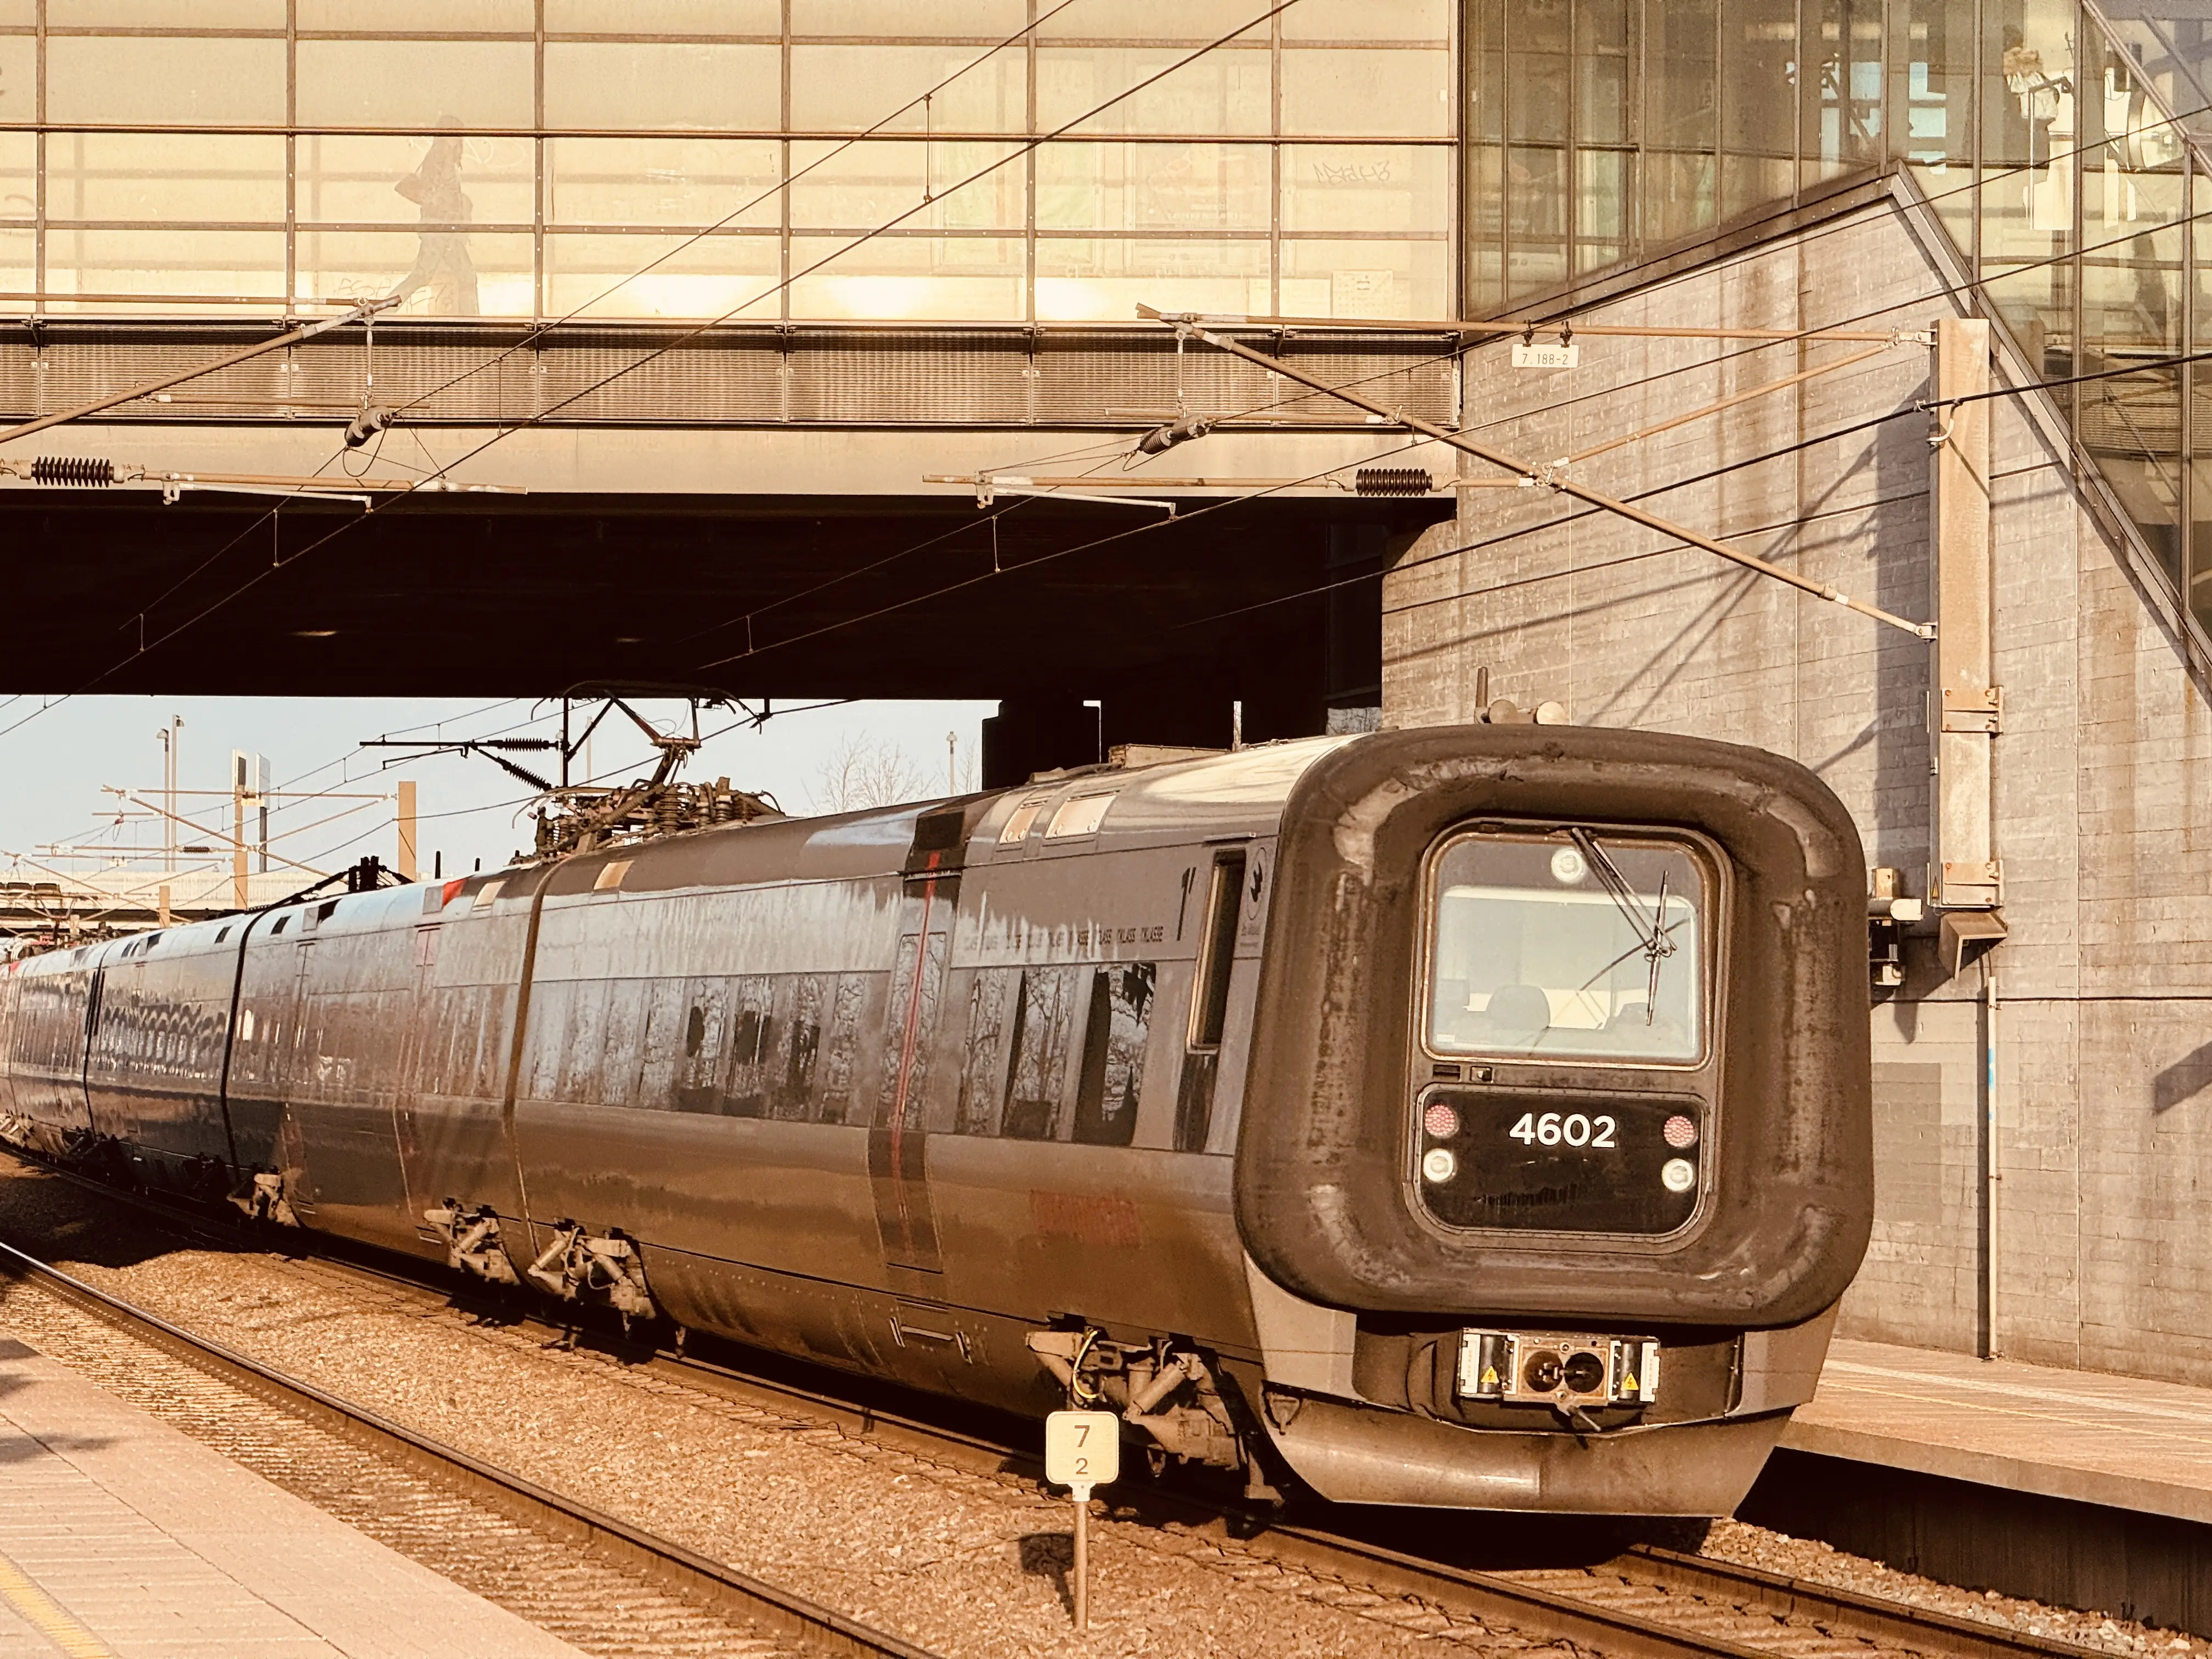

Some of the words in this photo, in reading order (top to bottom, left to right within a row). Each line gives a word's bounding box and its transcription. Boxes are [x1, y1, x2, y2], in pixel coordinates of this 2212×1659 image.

[1522, 353, 1568, 365] 7.188-2
[1509, 1112, 1616, 1148] 4602
[1074, 1425, 1090, 1447] 7
[1076, 1458, 1088, 1475] 2
